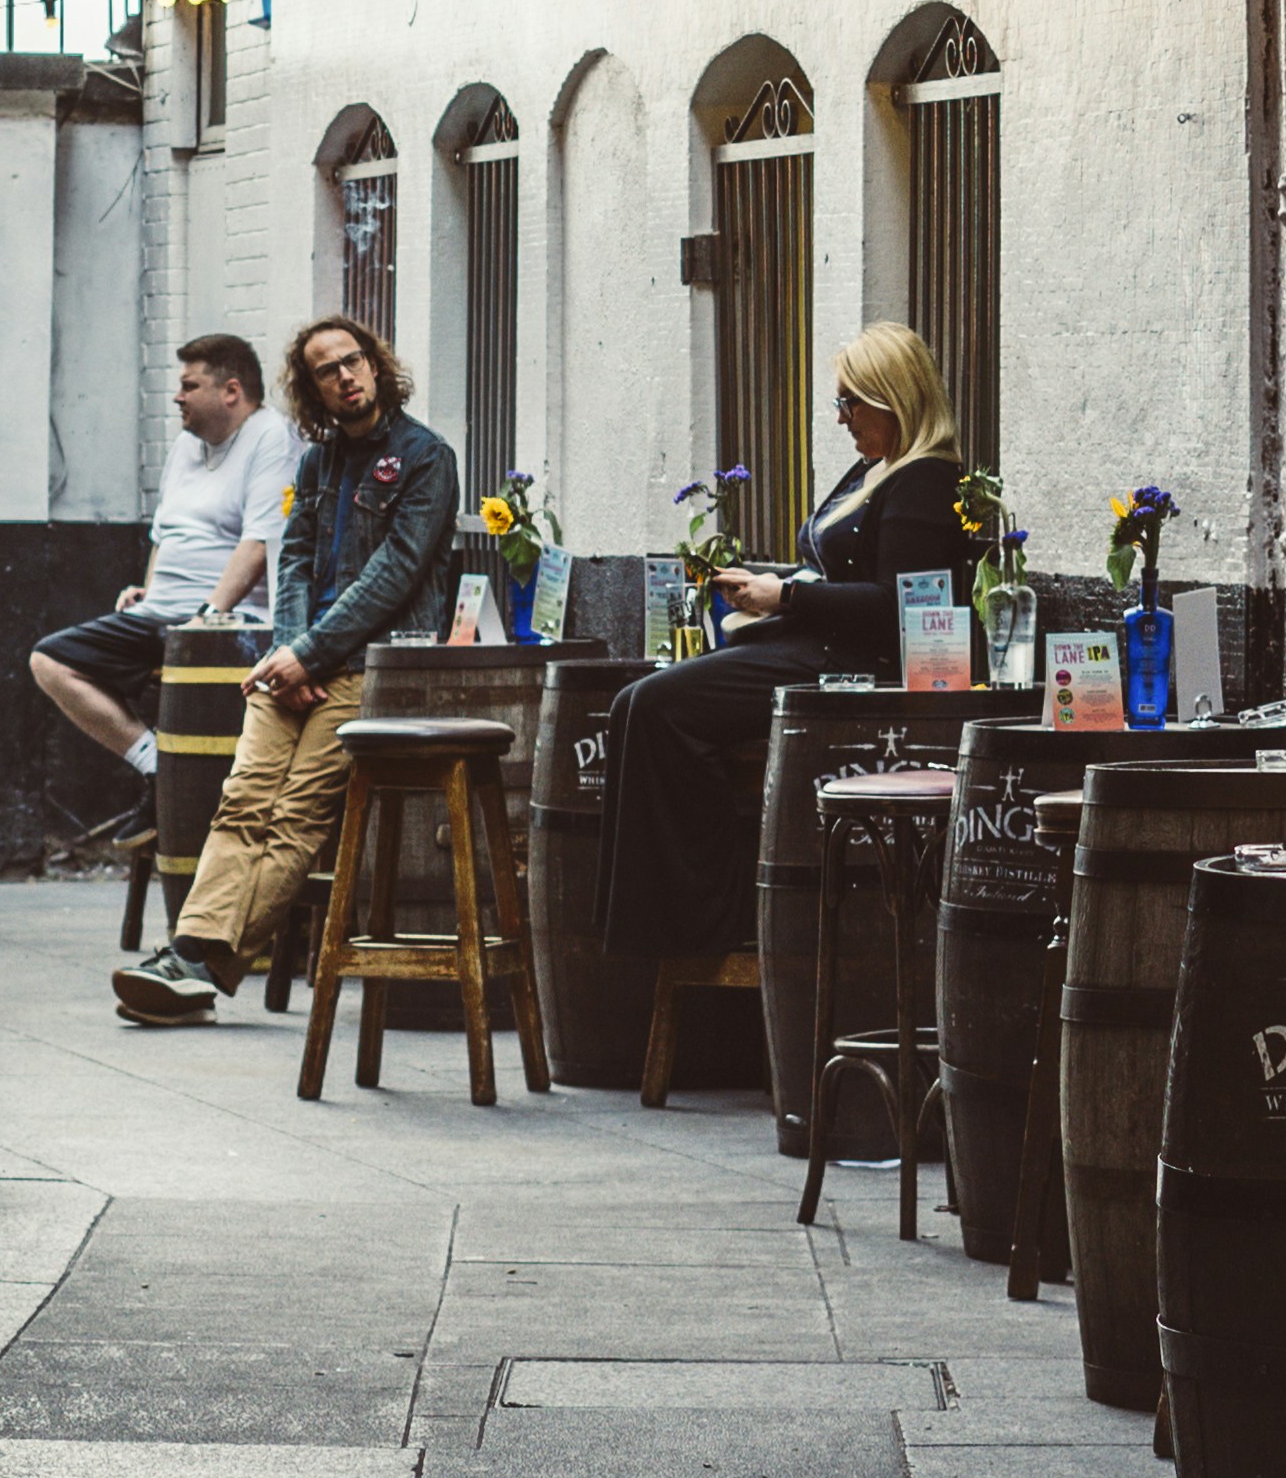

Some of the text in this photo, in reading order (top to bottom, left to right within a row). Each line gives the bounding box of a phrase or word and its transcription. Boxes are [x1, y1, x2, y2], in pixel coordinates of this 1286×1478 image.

[922, 618, 954, 631] LANE
[1055, 645, 1110, 664] LANE IPA
[955, 804, 1060, 856] DING
